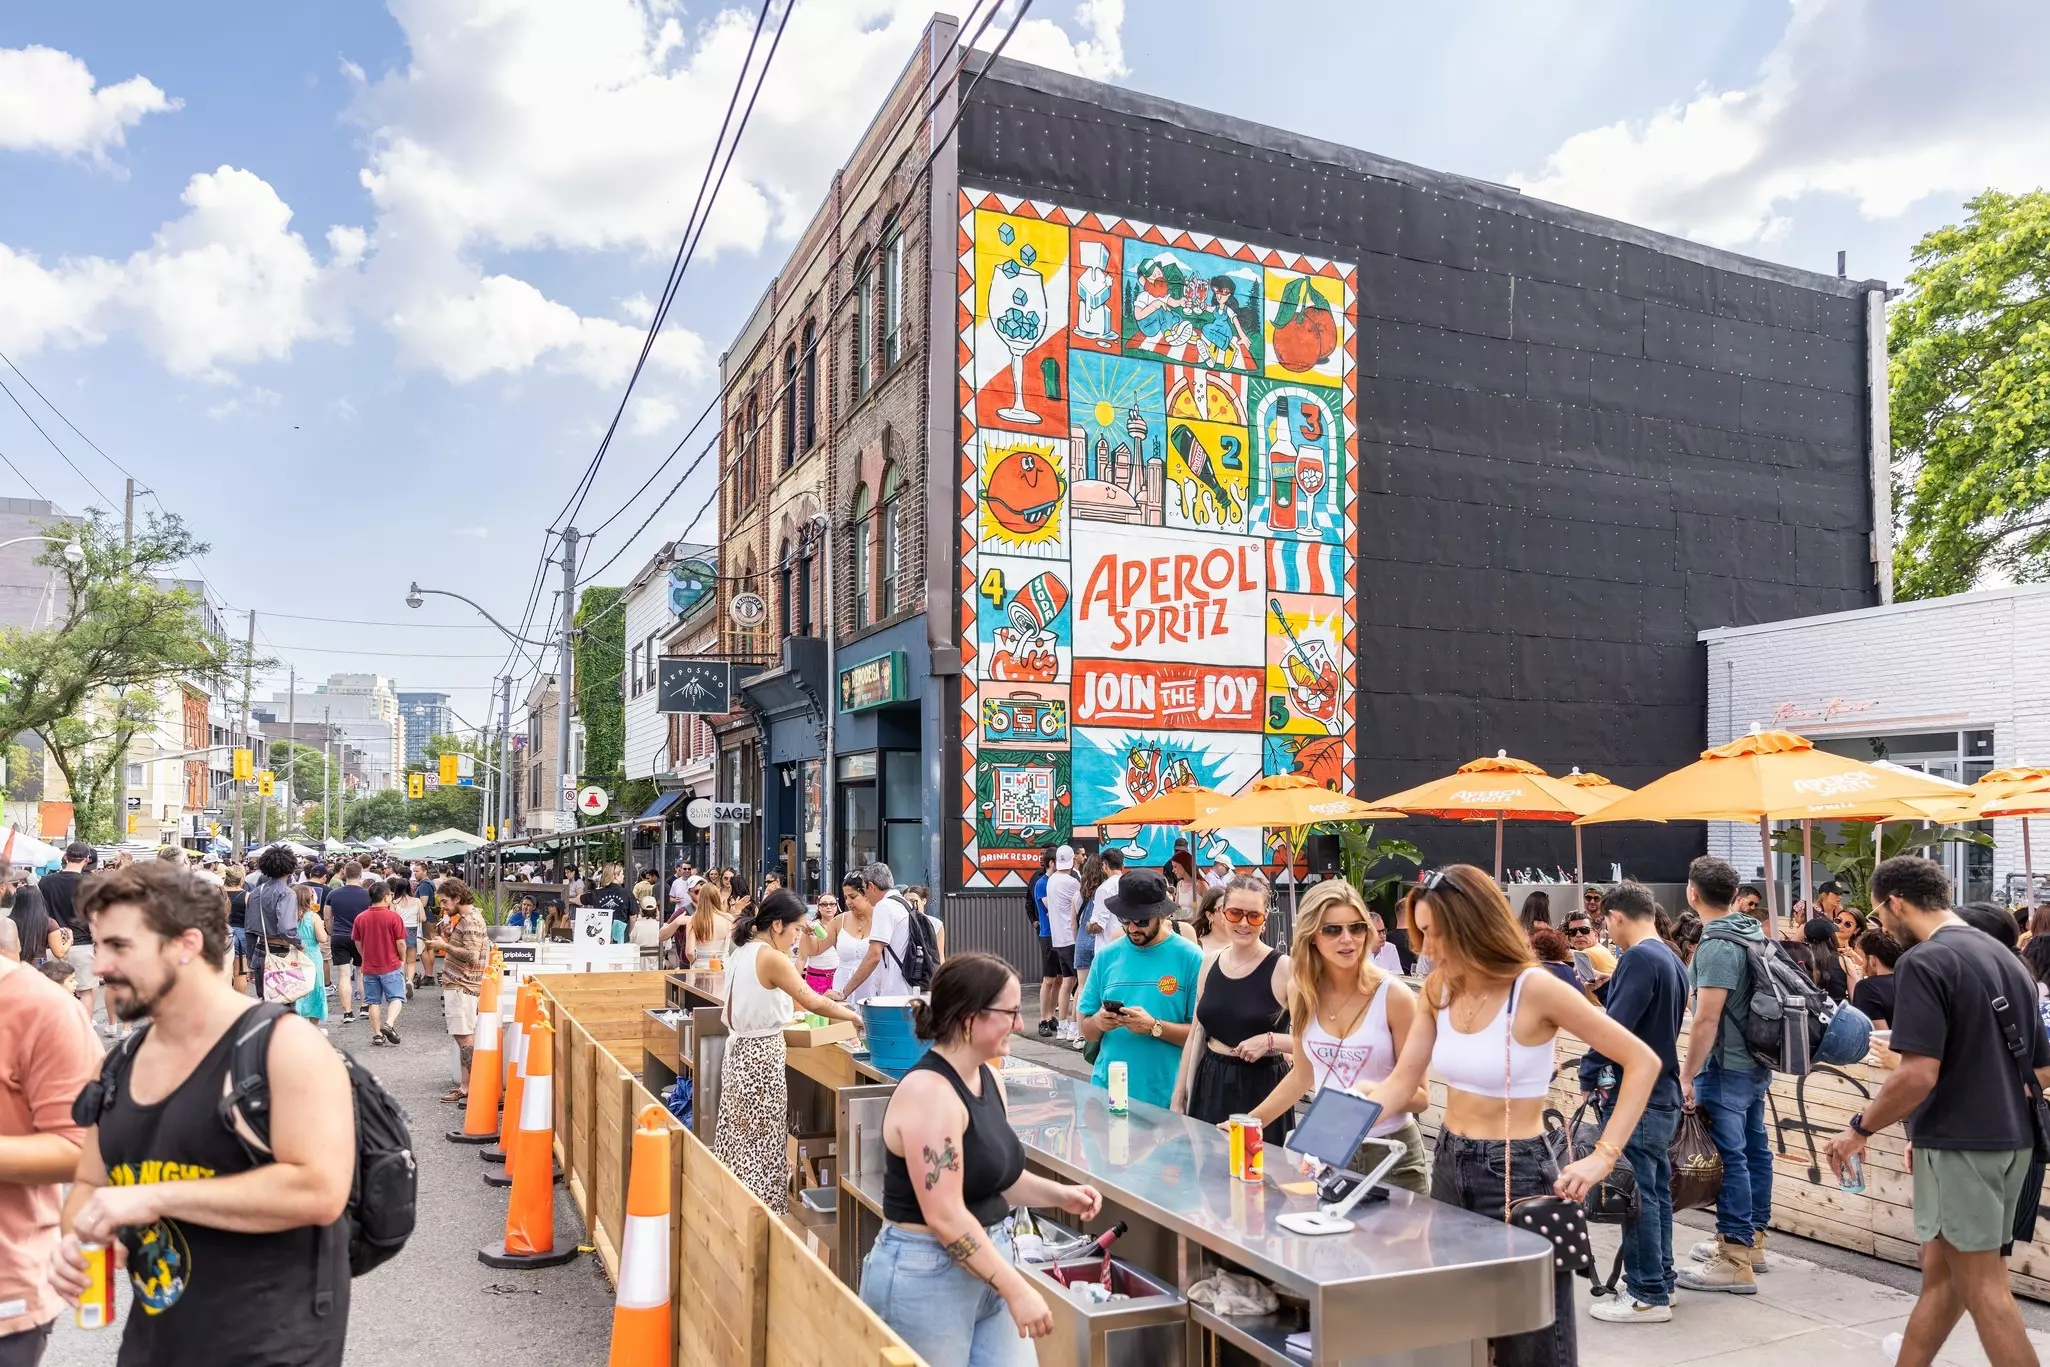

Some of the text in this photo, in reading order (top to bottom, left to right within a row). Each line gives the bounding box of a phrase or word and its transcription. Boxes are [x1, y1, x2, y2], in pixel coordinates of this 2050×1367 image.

[1300, 402, 1323, 442] 3
[1220, 435, 1242, 471] 2
[980, 567, 1007, 610] 4
[1079, 545, 1257, 621] APEROL
[1034, 578, 1054, 621] SODA
[663, 667, 724, 688] REPOSADO
[1077, 671, 1258, 720] JOIN THE JOY
[1268, 695, 1290, 730] 5
[1449, 788, 1527, 800] APEROL
[1792, 770, 1879, 794] APEROL
[714, 806, 750, 820] SAGE
[980, 852, 1009, 864] DRINK
[1160, 978, 1177, 986] SANTA
[1160, 983, 1176, 992] CRUZ
[1317, 1047, 1363, 1062] GUESS
